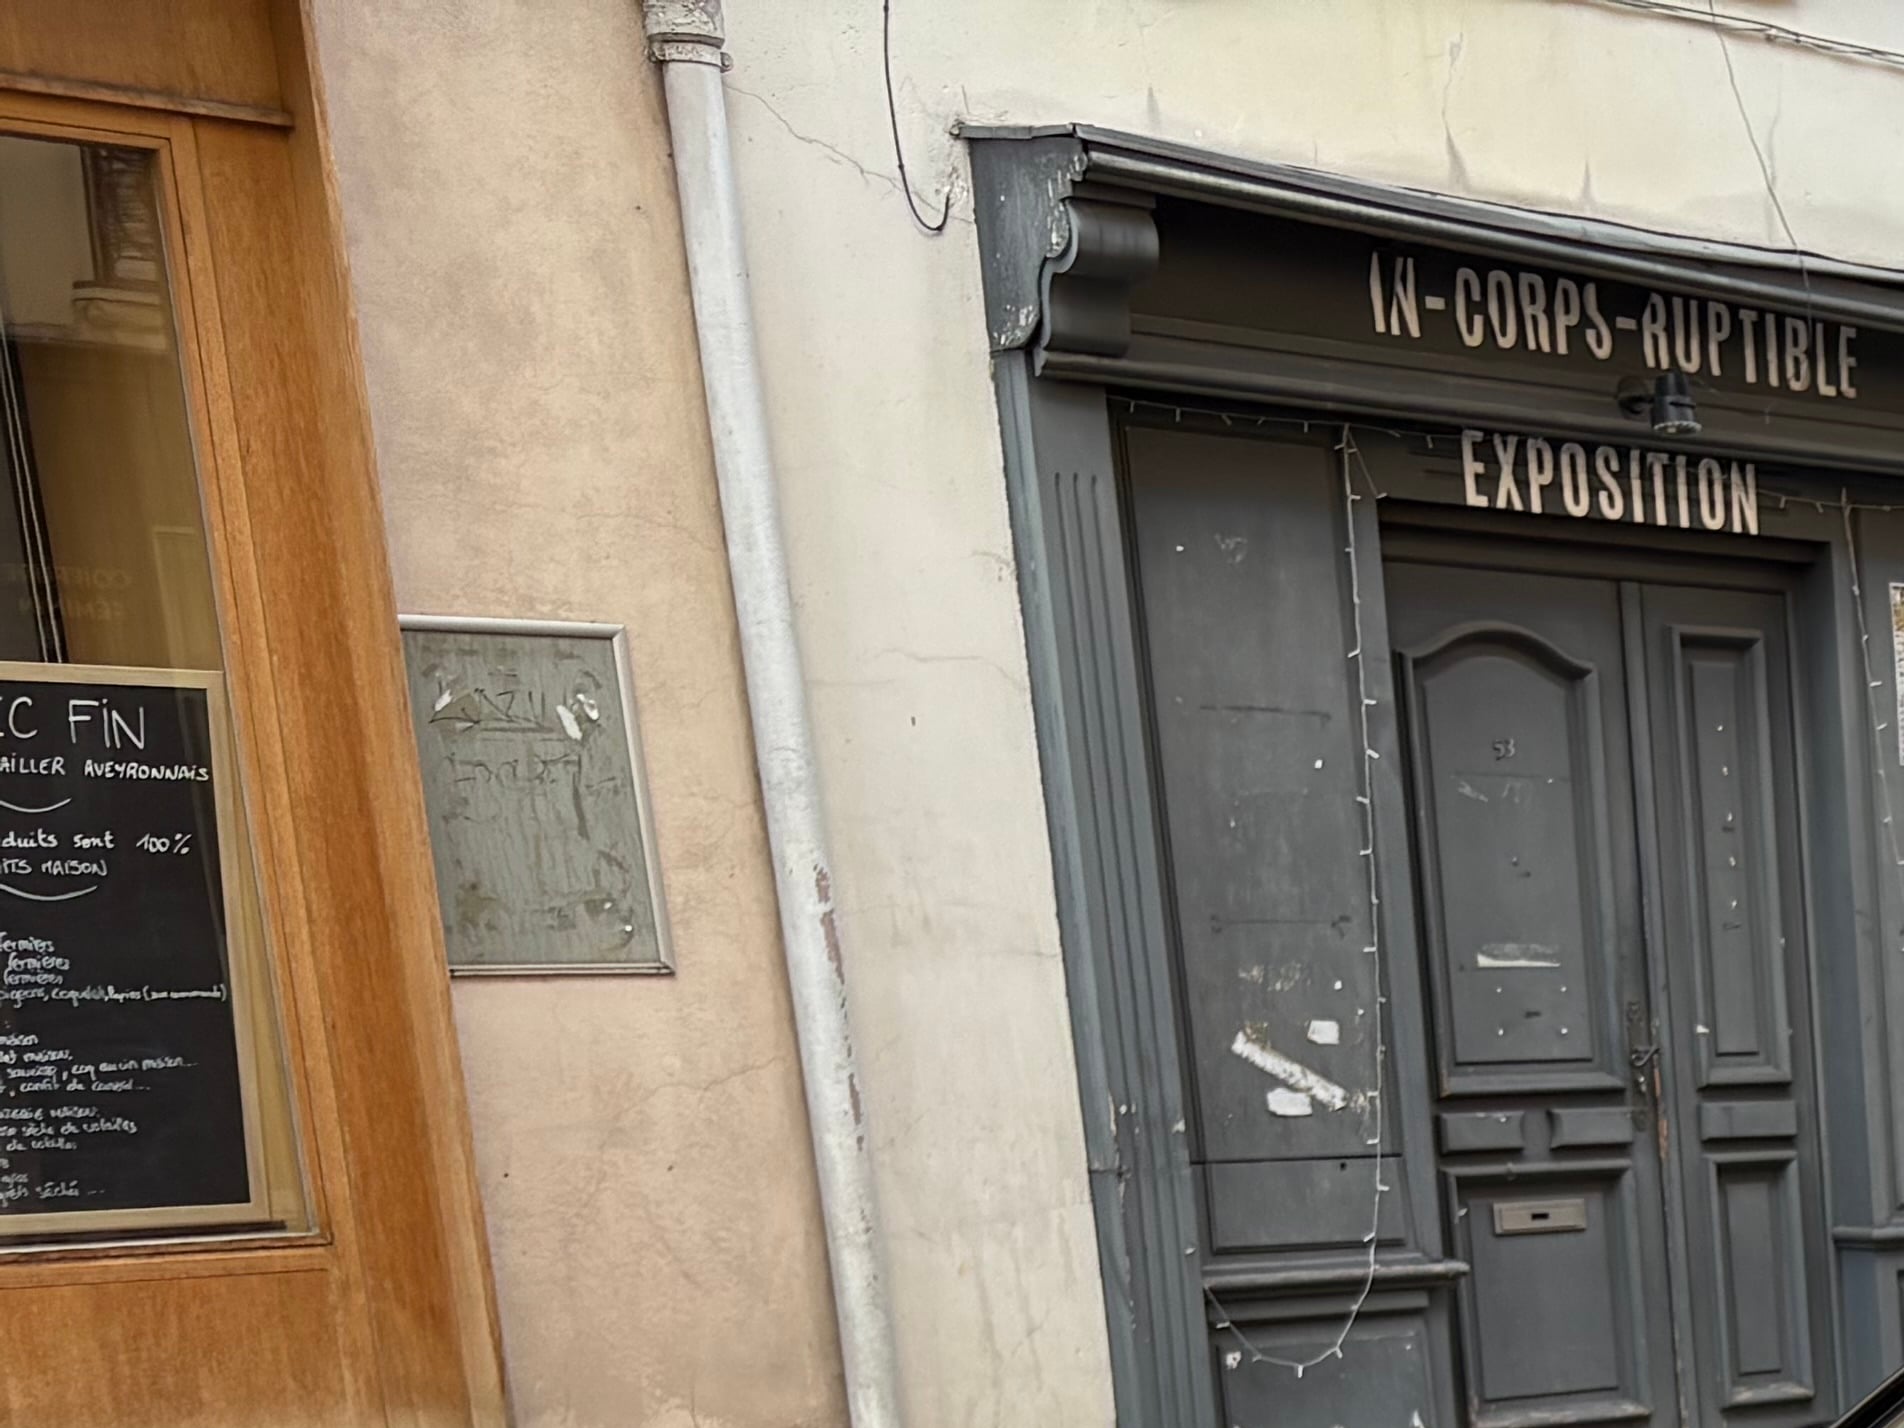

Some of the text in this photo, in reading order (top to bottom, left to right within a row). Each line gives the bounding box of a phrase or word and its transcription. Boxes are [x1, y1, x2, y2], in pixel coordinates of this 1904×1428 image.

[1369, 250, 1858, 398] IN-CORPS-RUPTIBLE
[1461, 428, 1760, 536] EXPOSITION
[73, 830, 114, 848] sont
